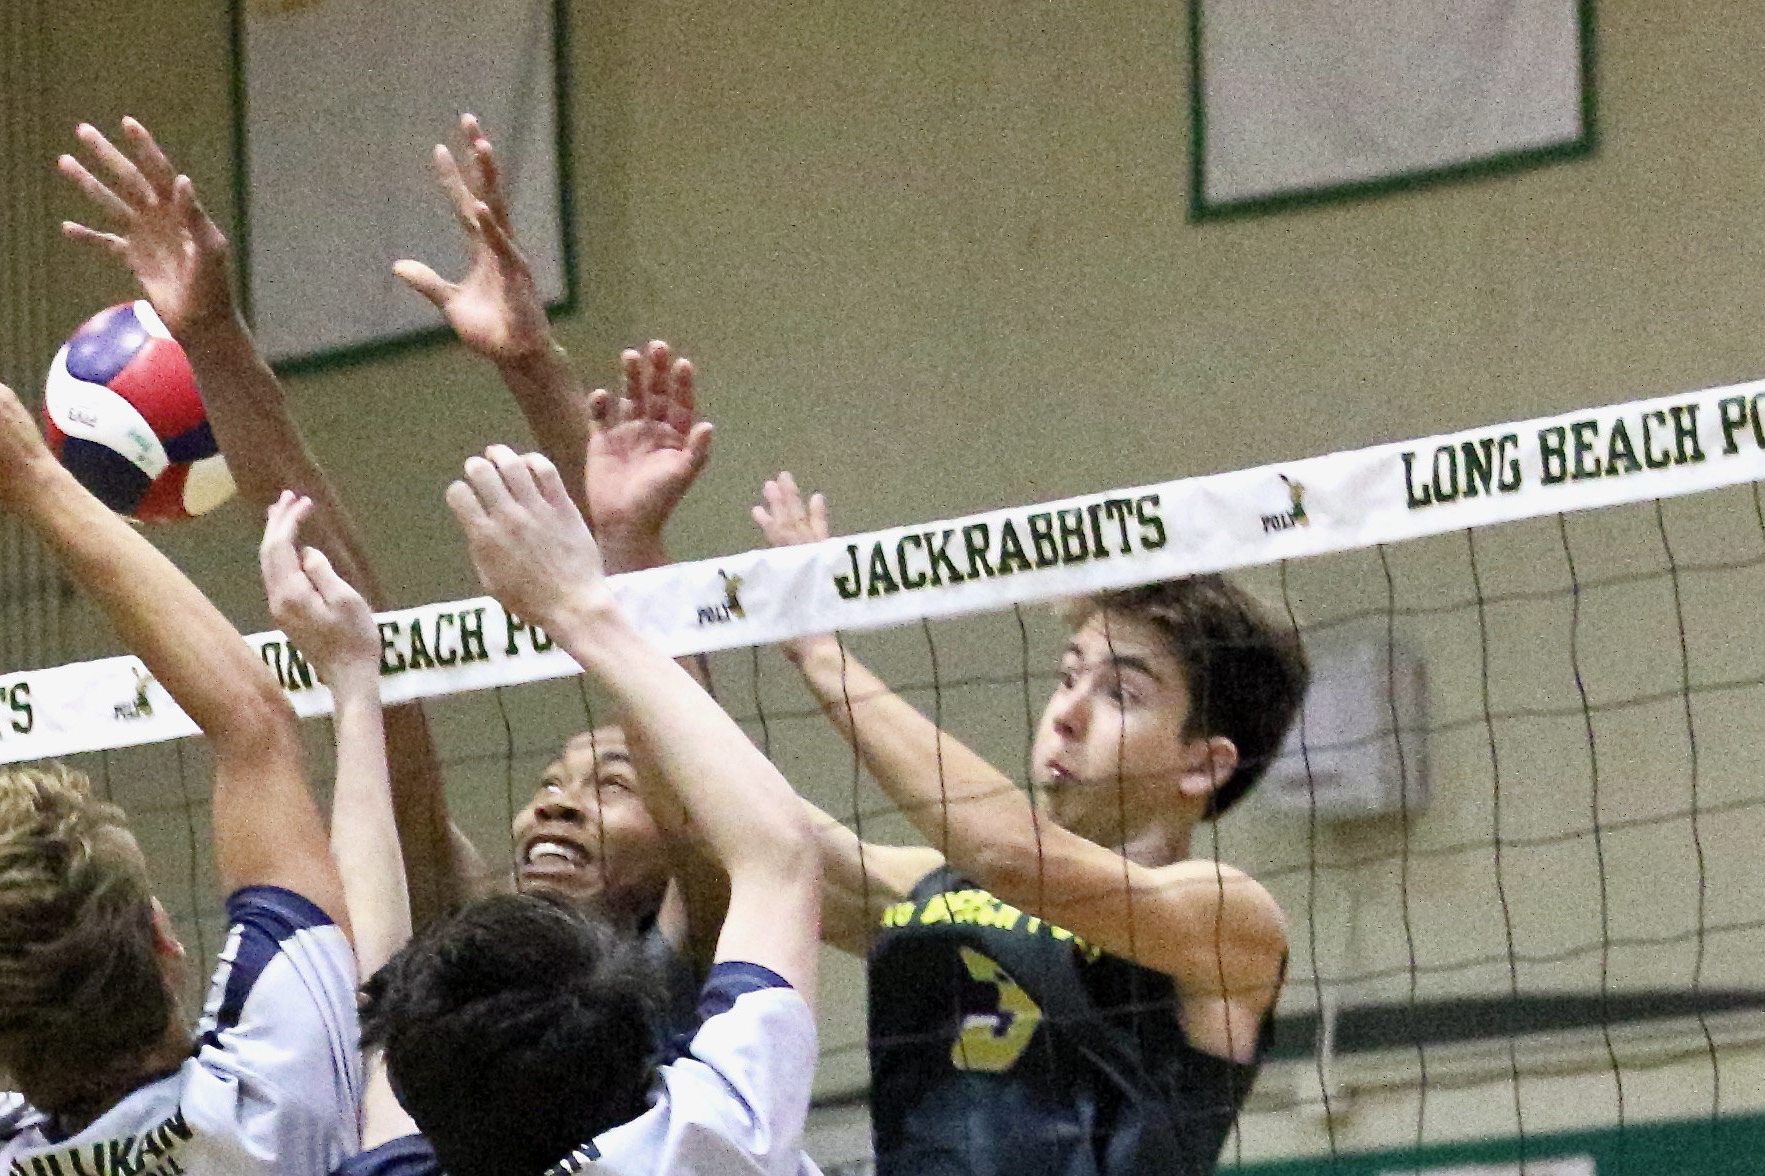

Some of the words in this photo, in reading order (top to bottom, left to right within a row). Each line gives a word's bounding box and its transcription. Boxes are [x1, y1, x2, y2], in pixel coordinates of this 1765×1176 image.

[1401, 433, 1523, 510] LONG
[1537, 403, 1705, 487] BEACH
[834, 495, 1168, 601] JACKRABBITS
[378, 606, 489, 675] EACH
[504, 611, 553, 656] PO
